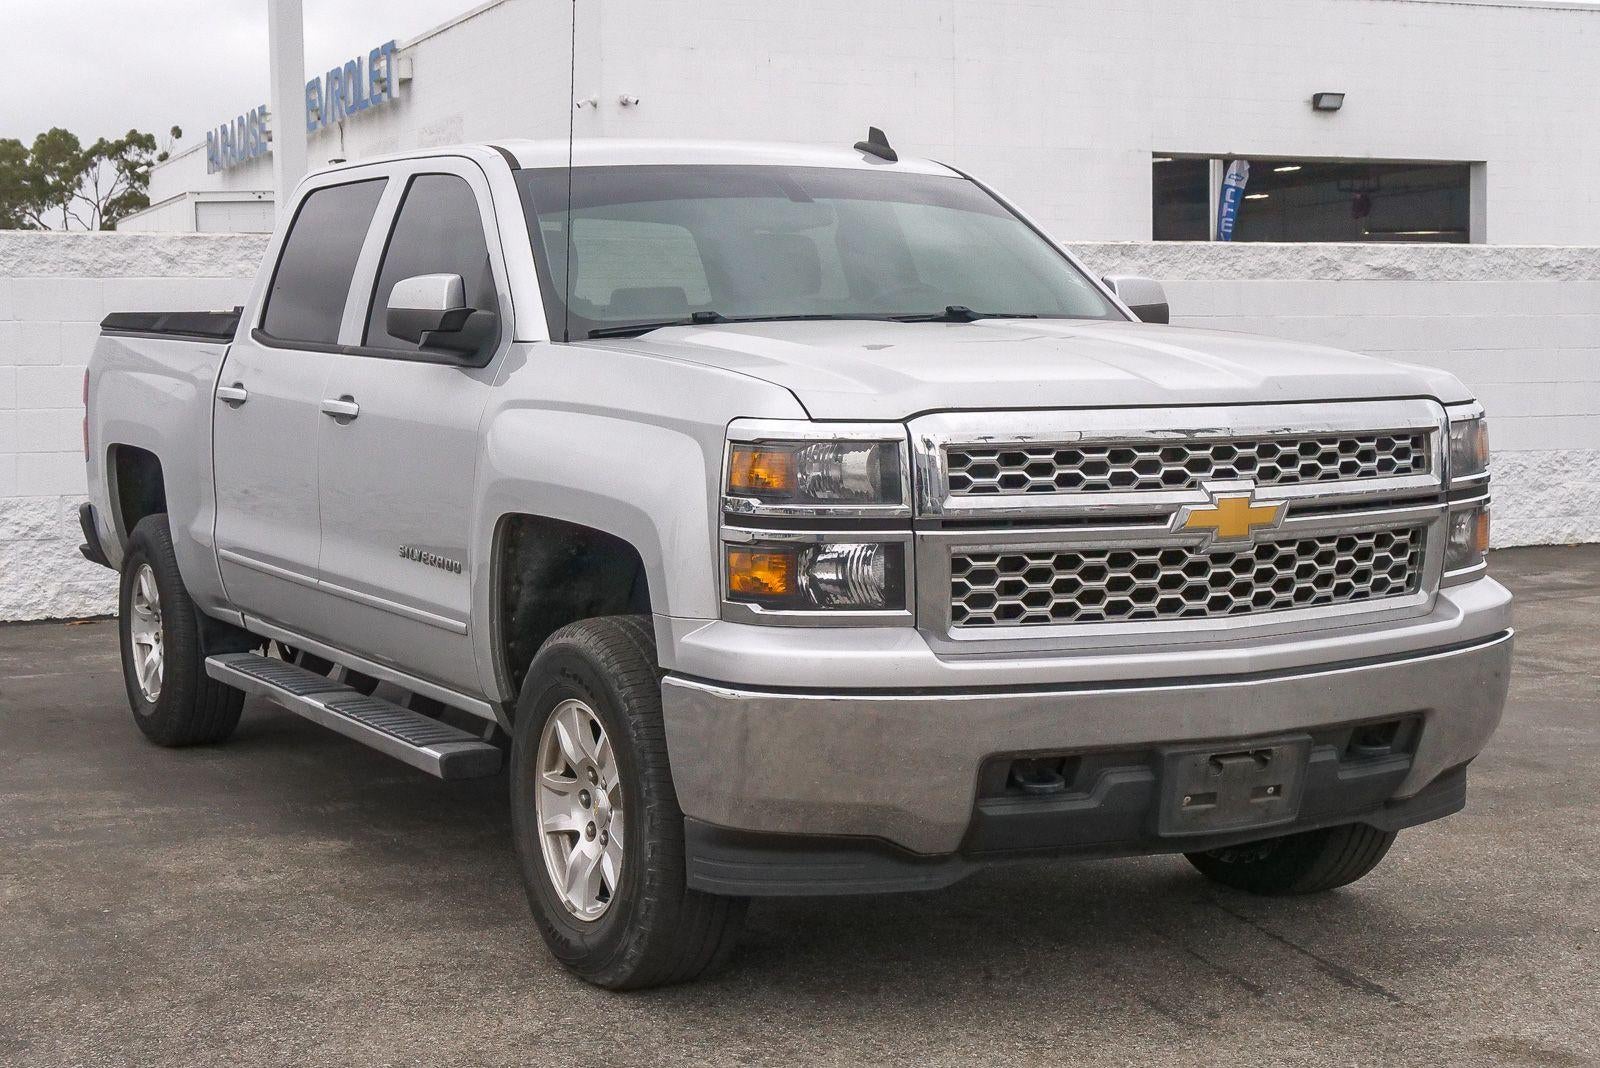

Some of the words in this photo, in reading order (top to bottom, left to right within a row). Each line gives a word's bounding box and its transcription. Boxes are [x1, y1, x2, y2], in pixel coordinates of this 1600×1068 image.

[207, 104, 266, 174] PARADISE
[305, 40, 396, 131] EVROLET
[399, 544, 462, 574] SILVERADO
